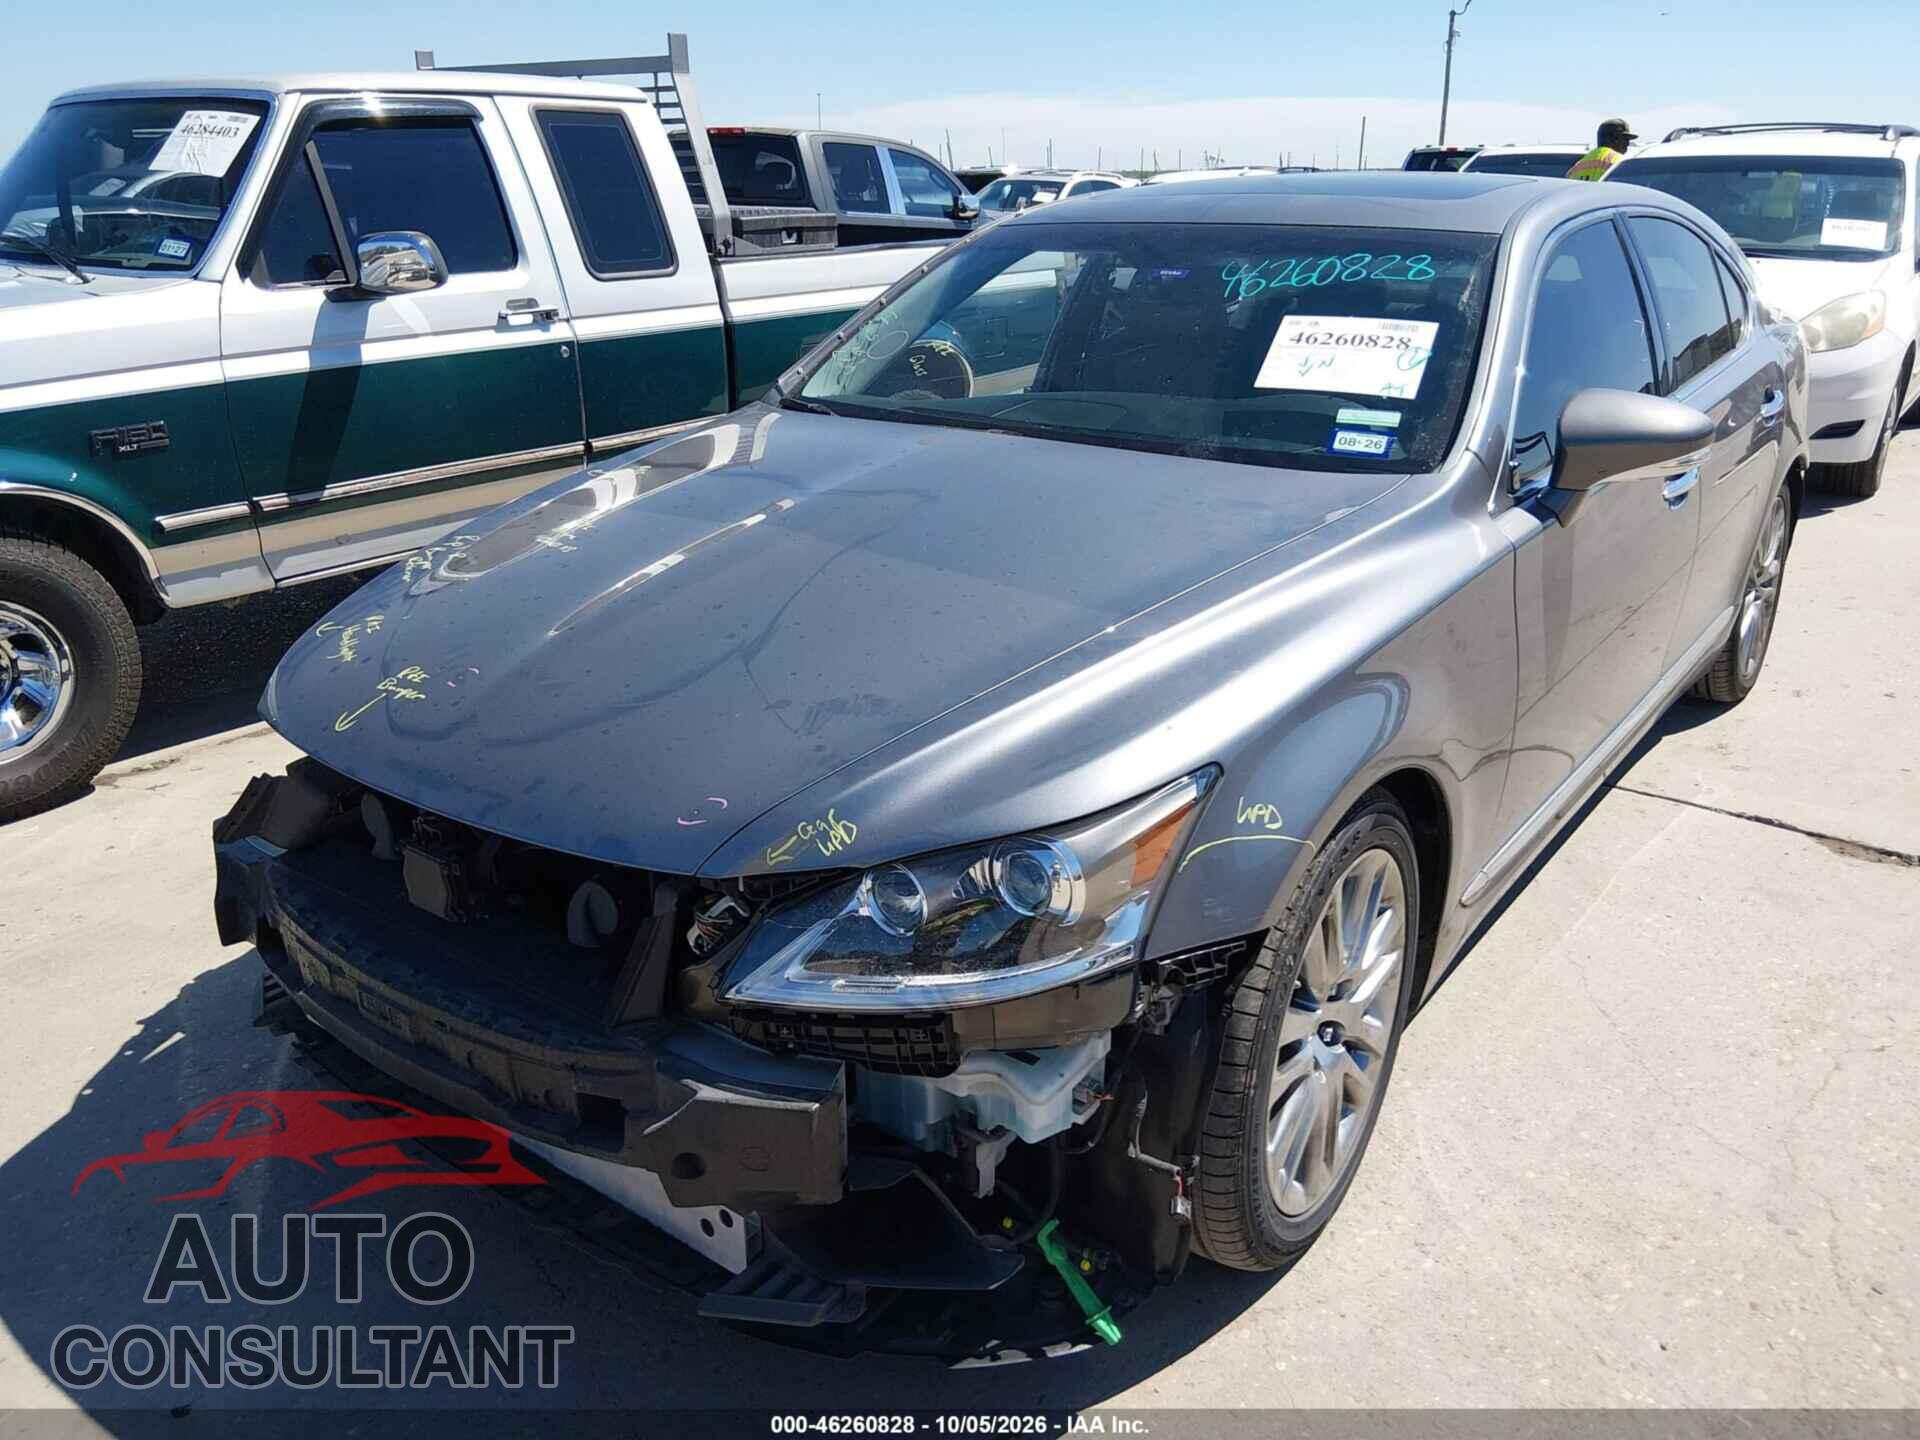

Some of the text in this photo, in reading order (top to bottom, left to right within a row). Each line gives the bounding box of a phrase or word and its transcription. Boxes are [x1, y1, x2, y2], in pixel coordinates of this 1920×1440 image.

[180, 123, 240, 139] 46284403
[1221, 253, 1437, 299] 46260828
[1288, 331, 1412, 350] 46260828
[118, 443, 139, 453] XLT
